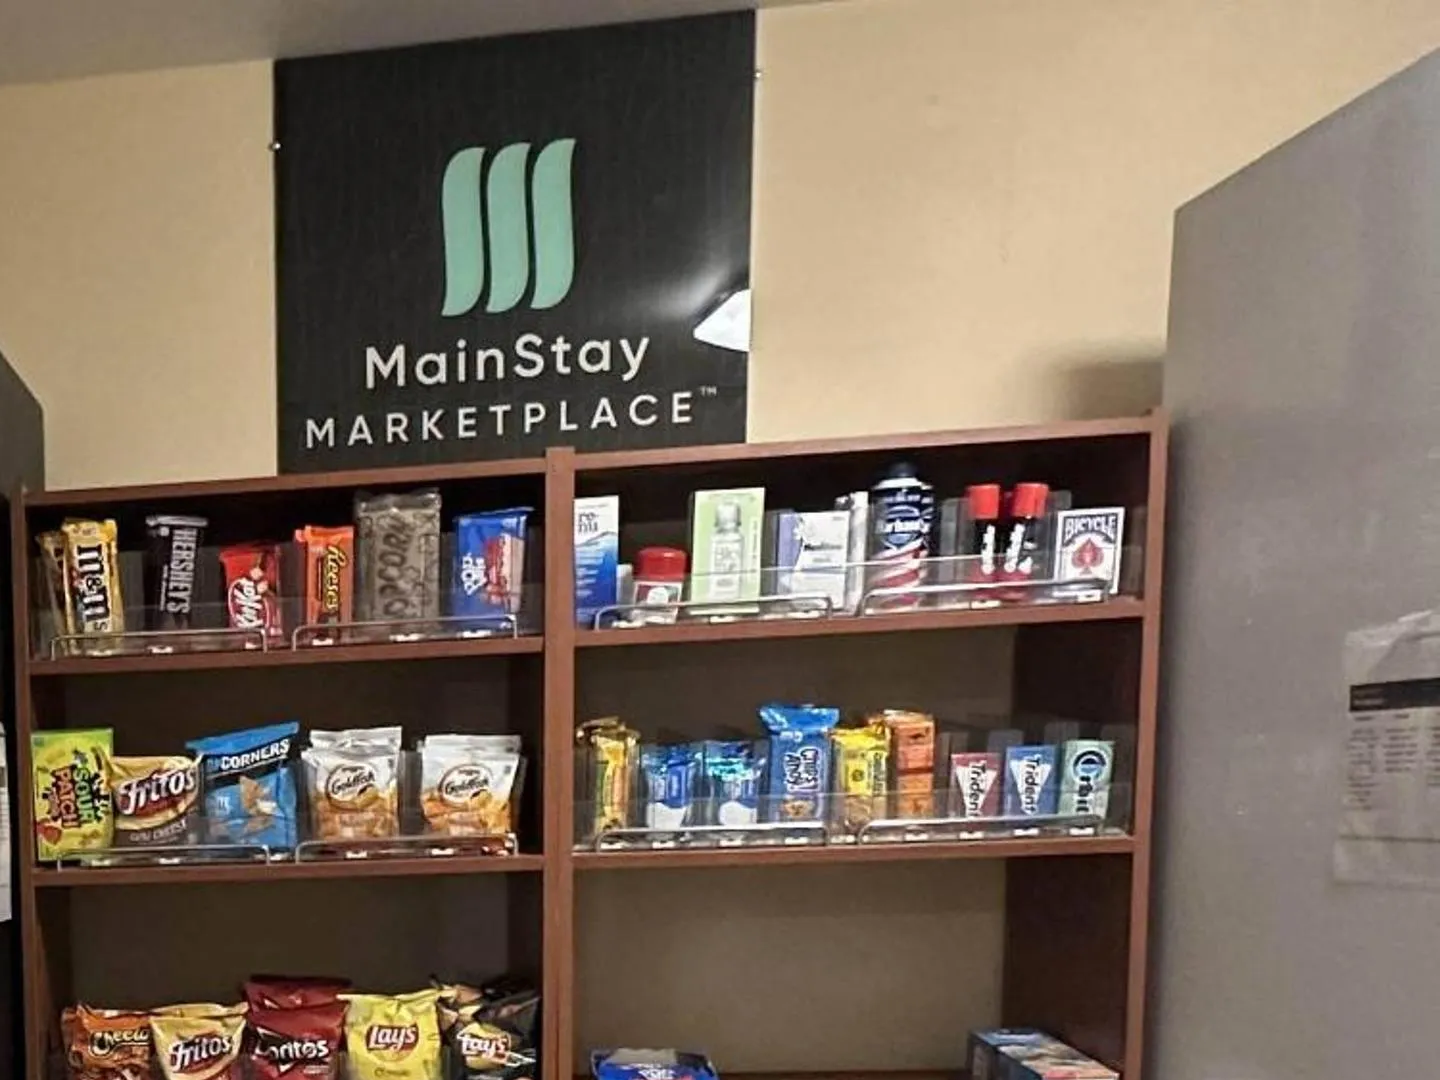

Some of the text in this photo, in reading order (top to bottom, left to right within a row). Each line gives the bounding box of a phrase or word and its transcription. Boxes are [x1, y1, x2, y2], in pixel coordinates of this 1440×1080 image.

[365, 332, 651, 391] MainStay
[305, 391, 693, 450] MARKETPLACE
[1064, 515, 1117, 539] BICYCLE
[376, 514, 413, 617] OPCORN
[56, 767, 79, 829] PATCH
[73, 764, 96, 822] SOUR
[968, 760, 986, 817] Trident
[1022, 755, 1041, 814] Trident
